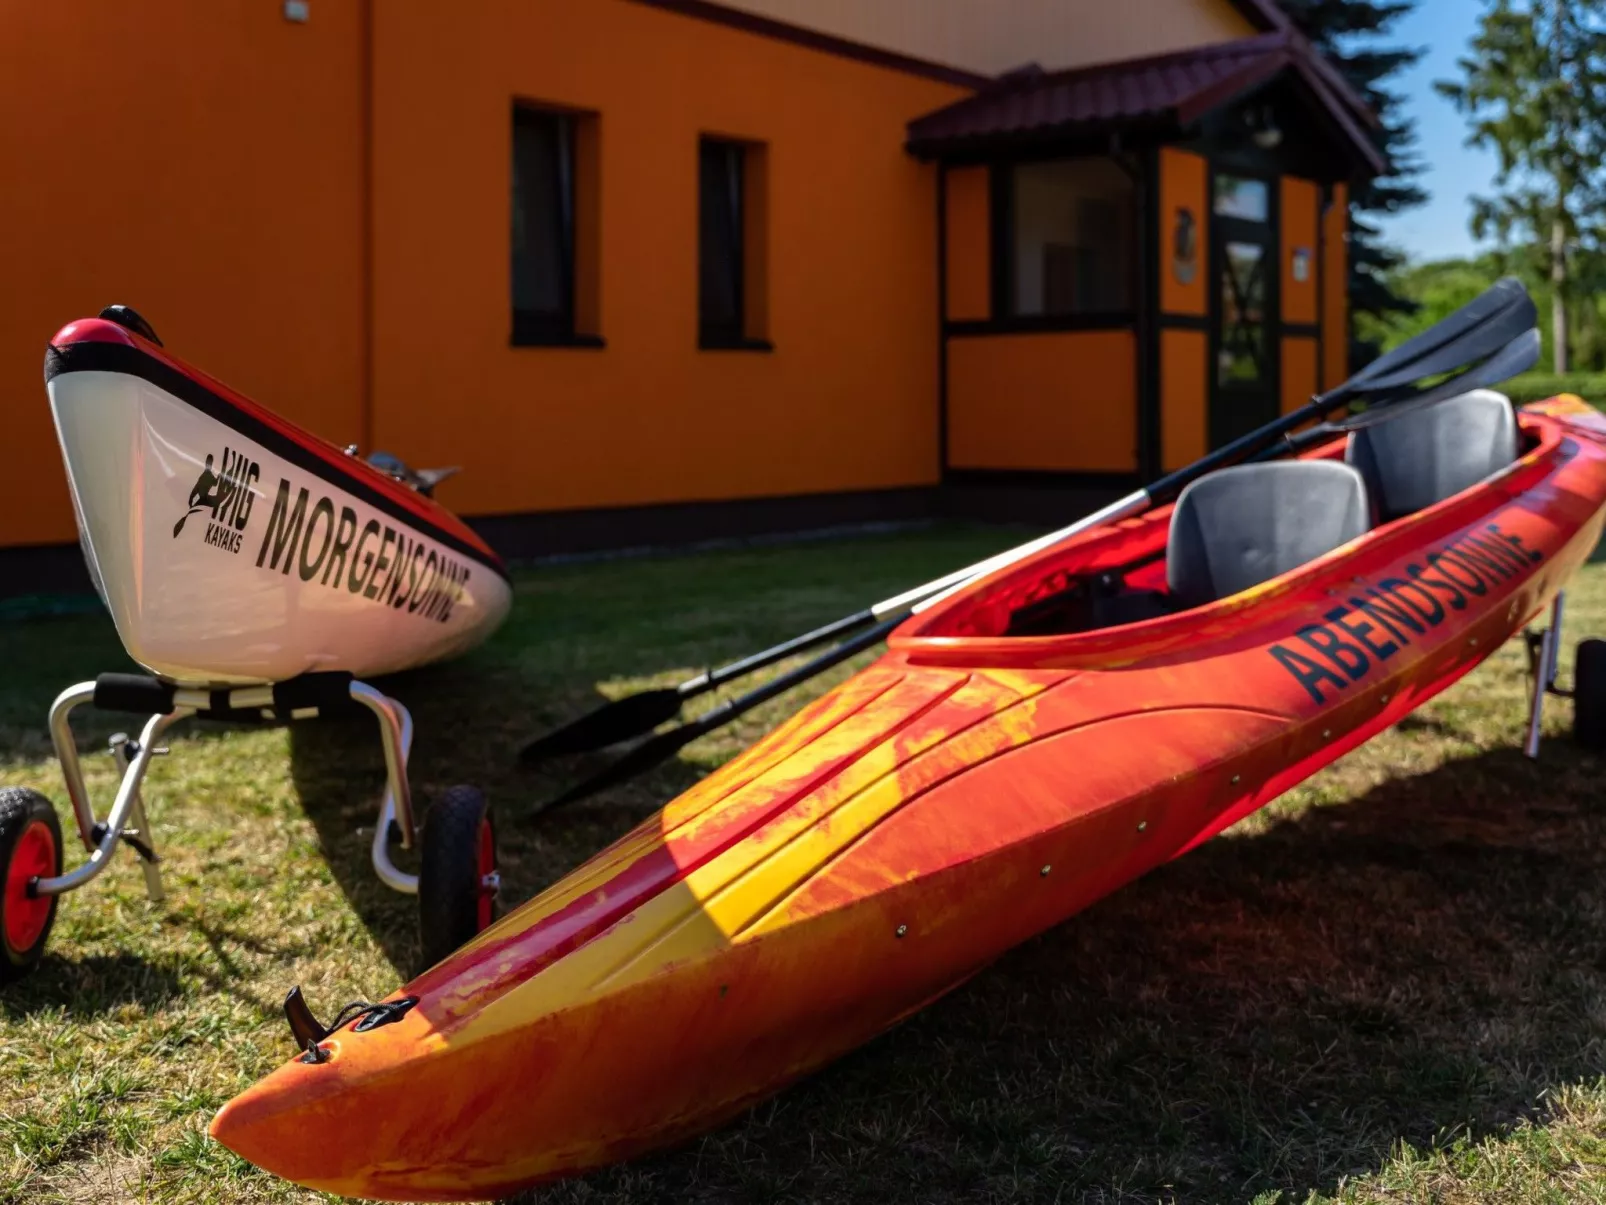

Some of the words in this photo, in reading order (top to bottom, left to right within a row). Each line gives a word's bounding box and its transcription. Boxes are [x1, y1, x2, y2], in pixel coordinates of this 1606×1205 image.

[204, 523, 243, 554] KAYAKS
[256, 478, 470, 623] MORGENSONNE
[1267, 524, 1542, 705] ABENDSONNE
